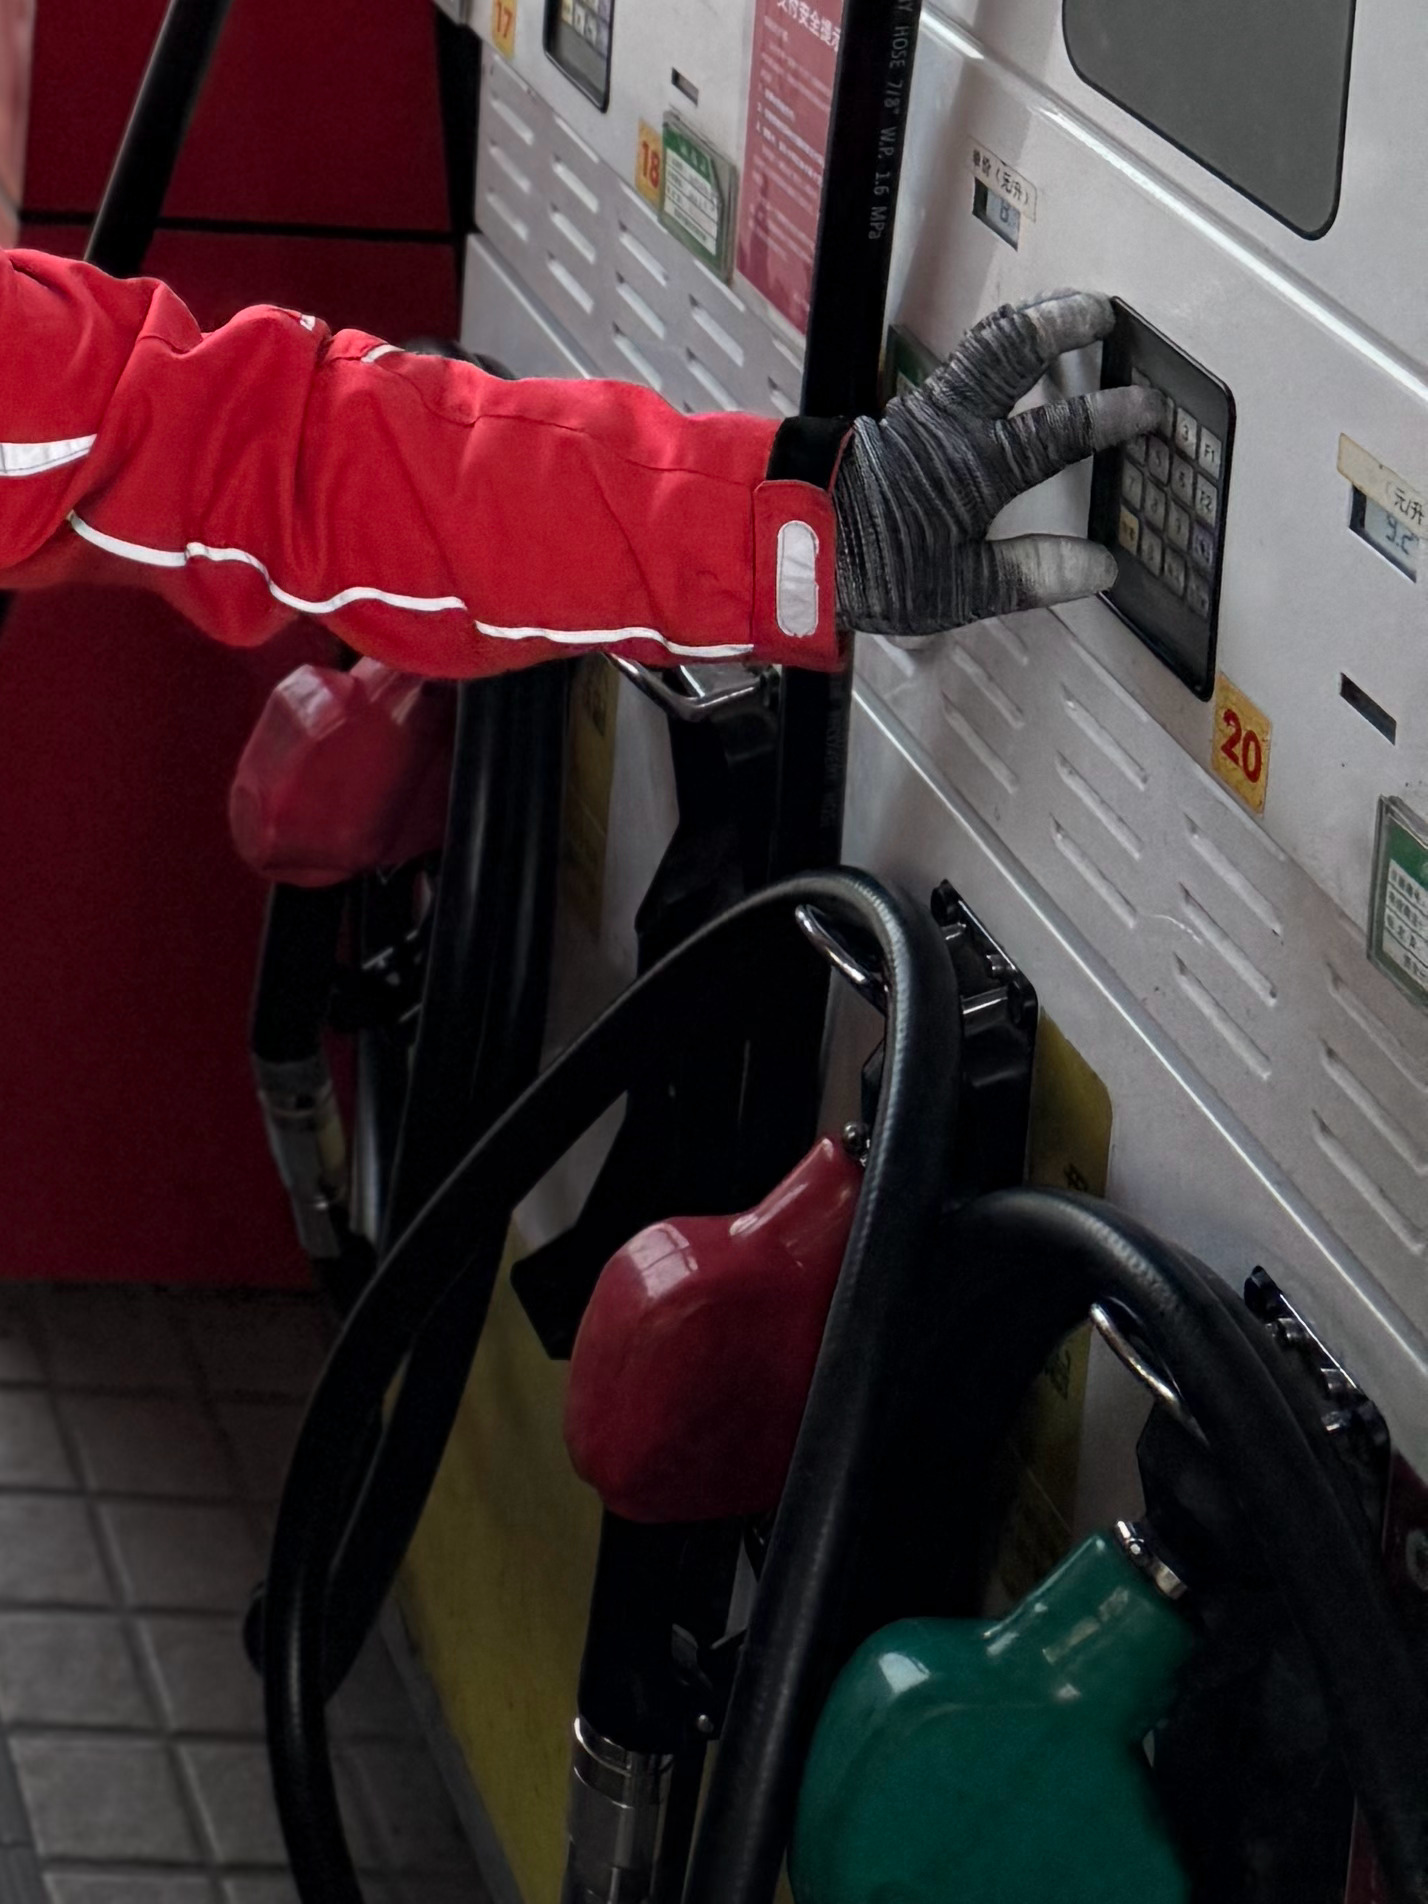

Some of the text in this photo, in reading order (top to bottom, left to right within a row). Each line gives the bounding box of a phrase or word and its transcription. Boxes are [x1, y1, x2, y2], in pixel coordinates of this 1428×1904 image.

[496, 0, 513, 38] 17
[889, 25, 910, 69] HOSE
[642, 140, 661, 190] 18
[873, 170, 890, 196] 1.6
[868, 205, 887, 240] MPa
[1221, 708, 1262, 784] 20
